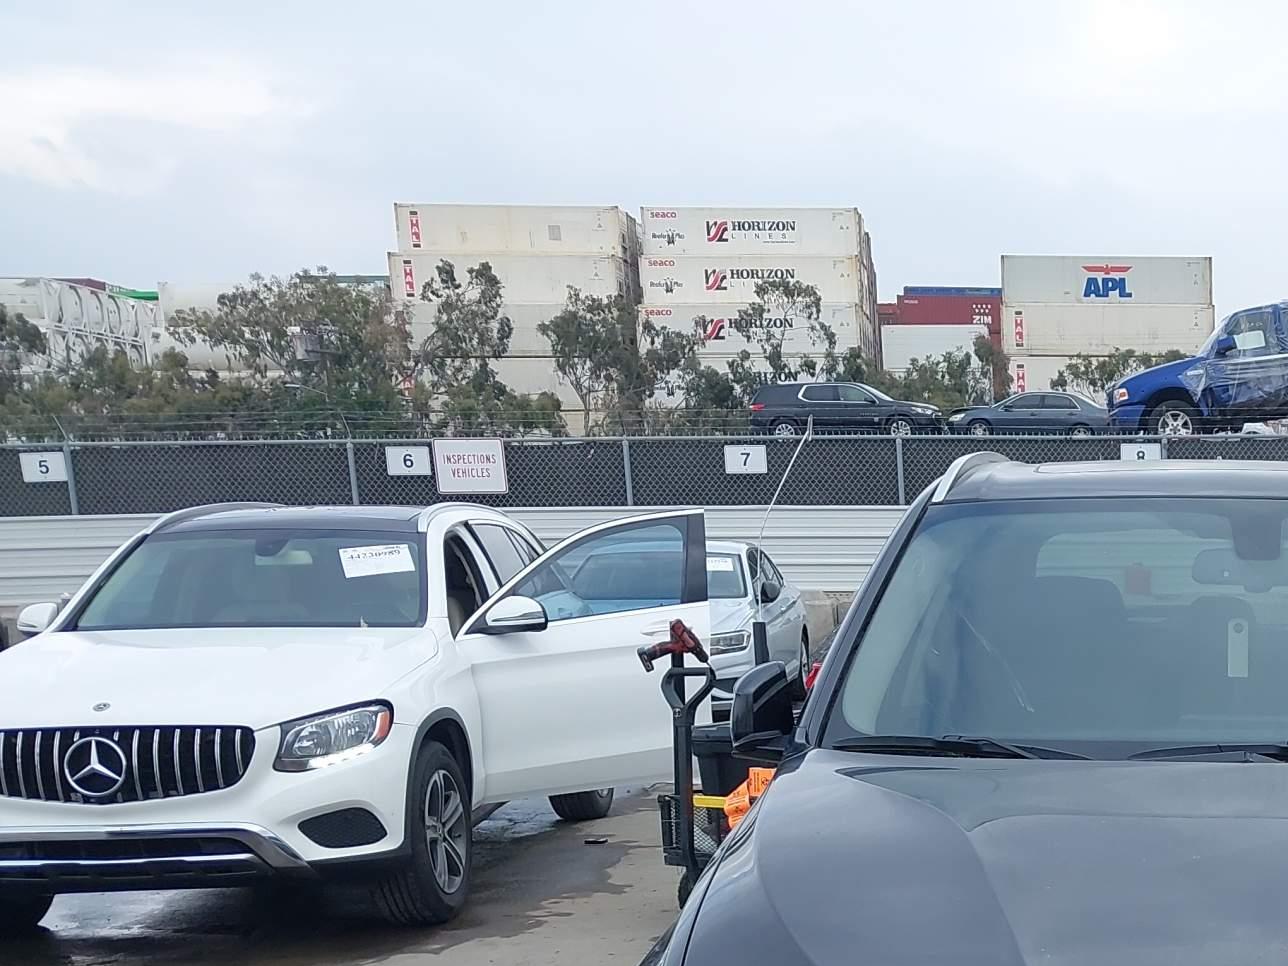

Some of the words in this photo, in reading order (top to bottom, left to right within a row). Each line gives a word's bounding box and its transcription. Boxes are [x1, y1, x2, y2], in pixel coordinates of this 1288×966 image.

[649, 211, 677, 219] seaco
[730, 220, 796, 232] HORIZON
[731, 232, 787, 240] LINES
[647, 259, 675, 267] seaco
[729, 268, 795, 280] HORIZON
[1083, 277, 1133, 298] APL
[972, 315, 992, 325] ZIM
[403, 453, 414, 469] 6
[442, 453, 497, 465] INSPECTIONS
[740, 452, 751, 467] 7
[38, 459, 50, 475] 5
[450, 467, 492, 479] VEHICLES
